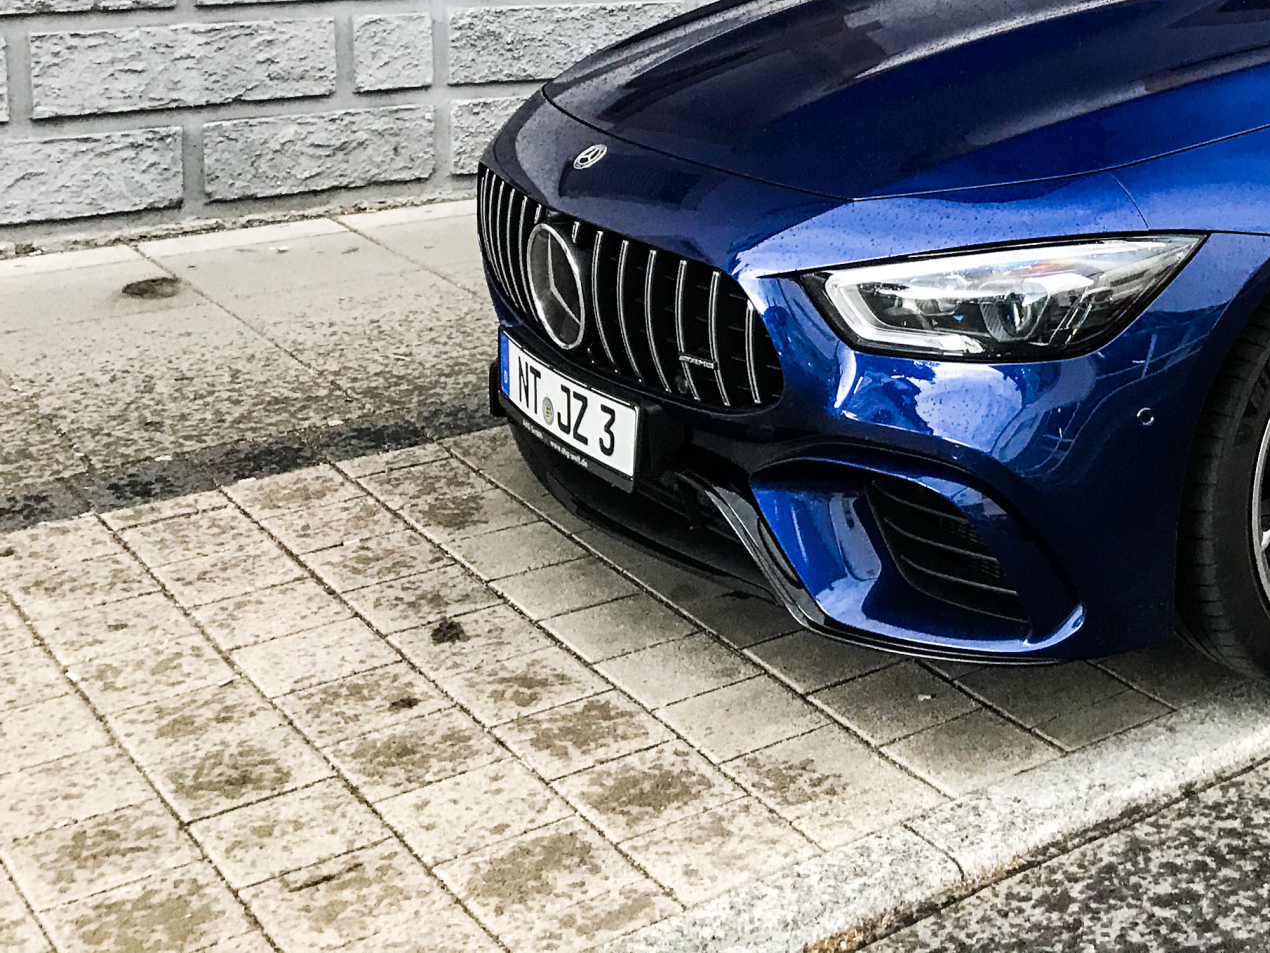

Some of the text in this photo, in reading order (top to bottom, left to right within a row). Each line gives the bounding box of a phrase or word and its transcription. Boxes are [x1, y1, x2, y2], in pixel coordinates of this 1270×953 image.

[517, 355, 541, 415] NT
[557, 384, 588, 446] JZ
[599, 404, 616, 456] 3
